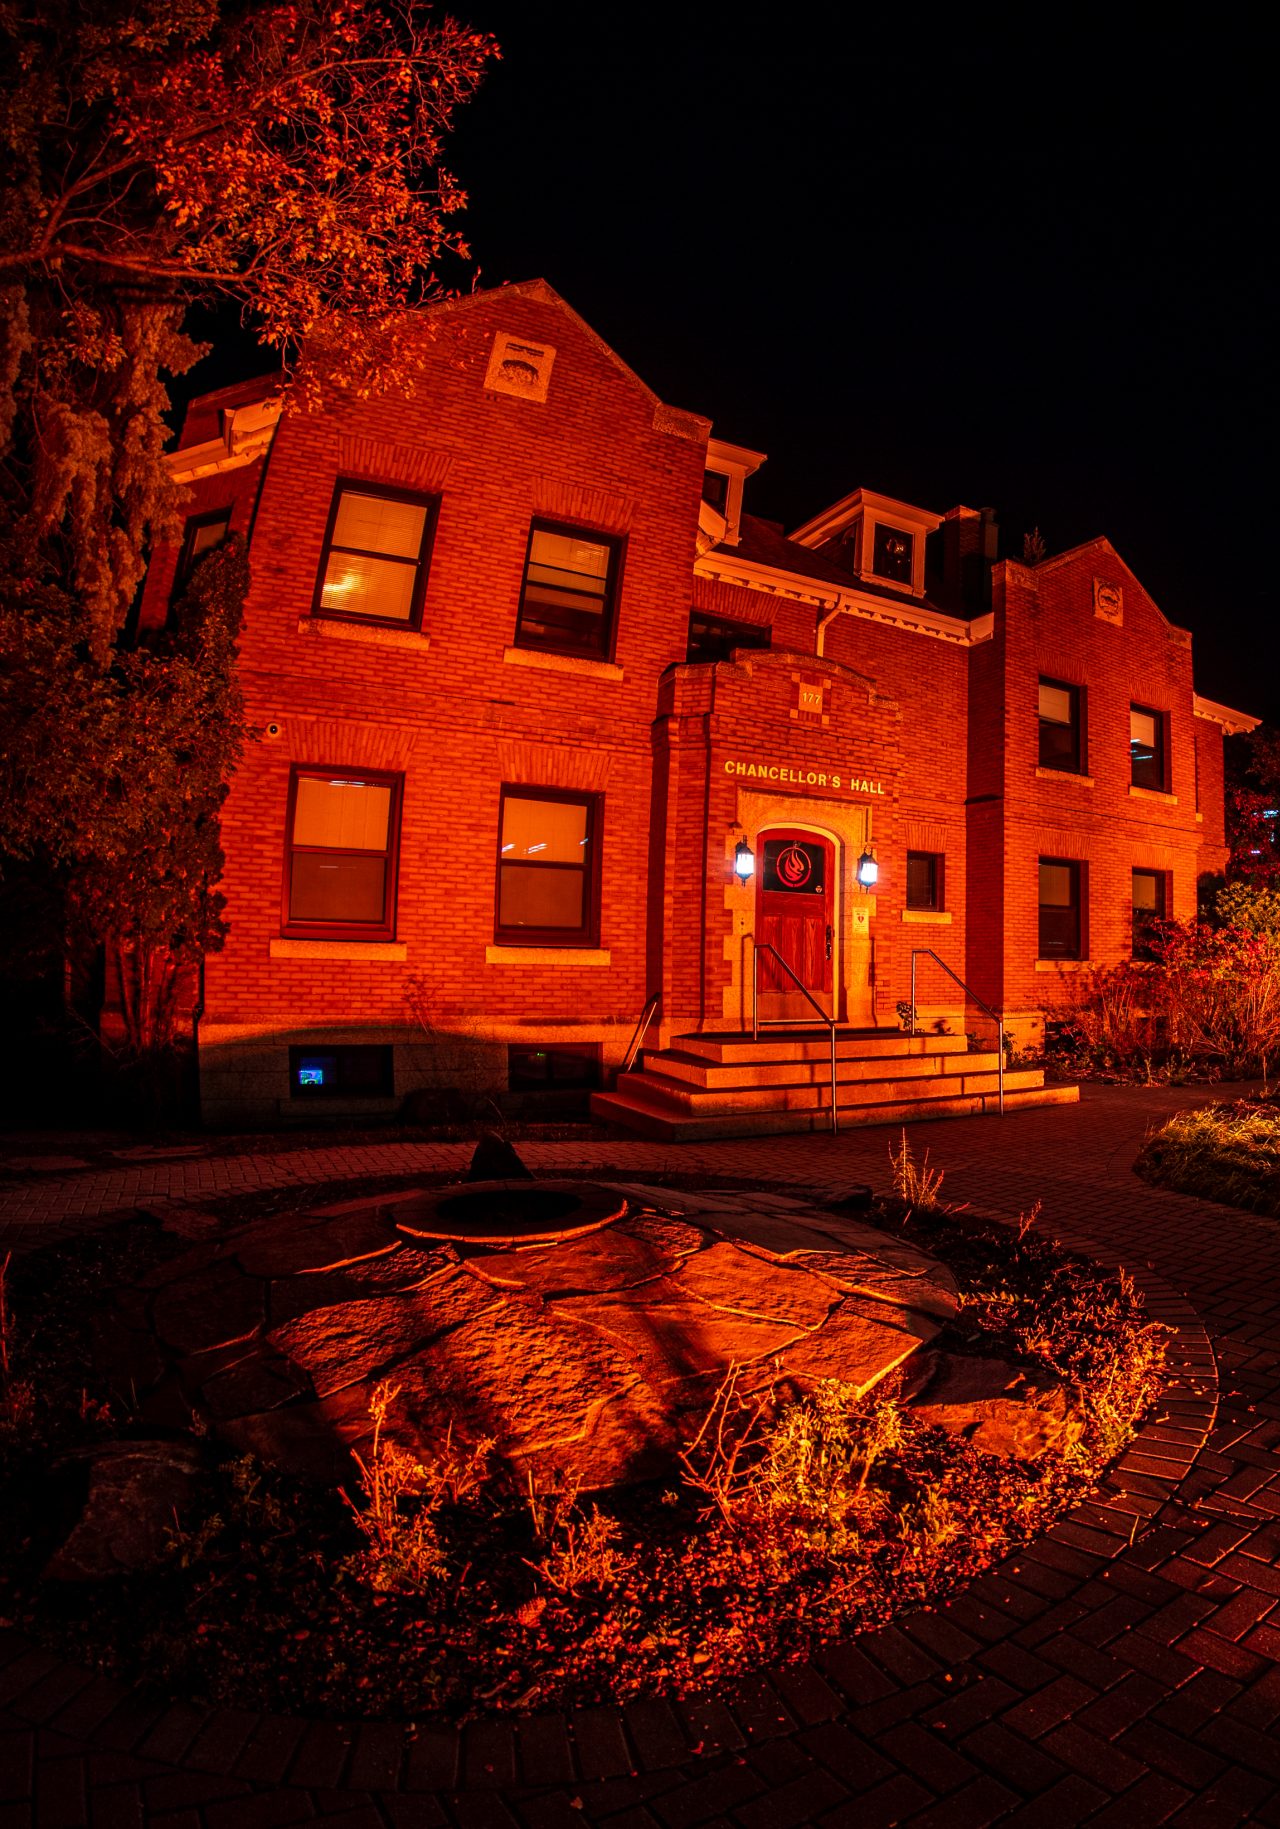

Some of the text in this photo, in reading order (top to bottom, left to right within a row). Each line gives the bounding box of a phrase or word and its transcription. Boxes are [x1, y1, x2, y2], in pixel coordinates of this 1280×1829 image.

[802, 692, 821, 705] 177
[724, 760, 885, 795] CHANCELLOR'S HALL
